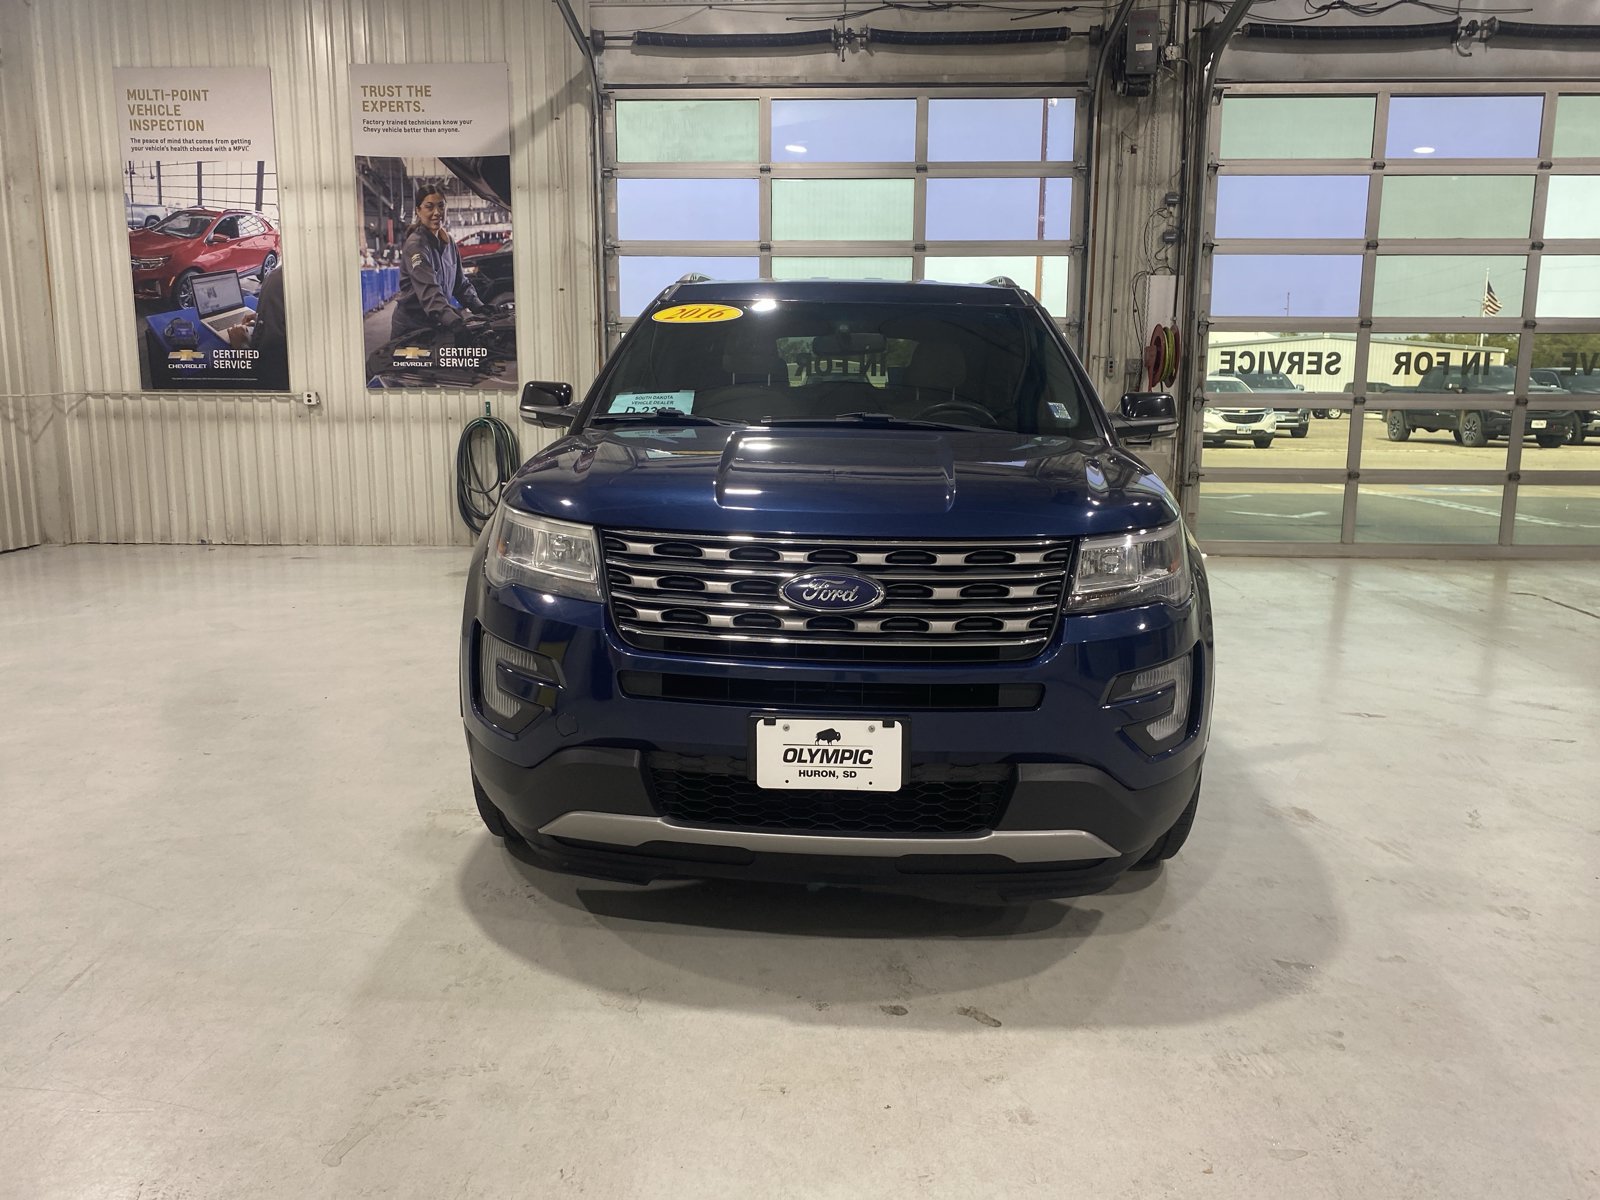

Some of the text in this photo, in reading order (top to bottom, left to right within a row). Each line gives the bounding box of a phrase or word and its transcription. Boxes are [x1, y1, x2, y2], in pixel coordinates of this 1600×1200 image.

[127, 89, 209, 101] MULTI-POINT
[360, 85, 432, 98] TRUST THE
[128, 104, 181, 116] VEHICLE
[362, 100, 425, 113] EXPERTS.
[129, 119, 205, 131] INSPECTION
[230, 138, 252, 146] getting
[664, 307, 731, 320] 2016
[212, 349, 260, 359] CERTIFIED
[439, 347, 488, 357] CERTIFIED
[213, 360, 252, 370] SERVICE
[439, 358, 480, 368] SERVICE
[802, 579, 859, 603] Ford
[782, 747, 874, 765] OLYMPIC
[798, 769, 857, 779] HURON, SD
